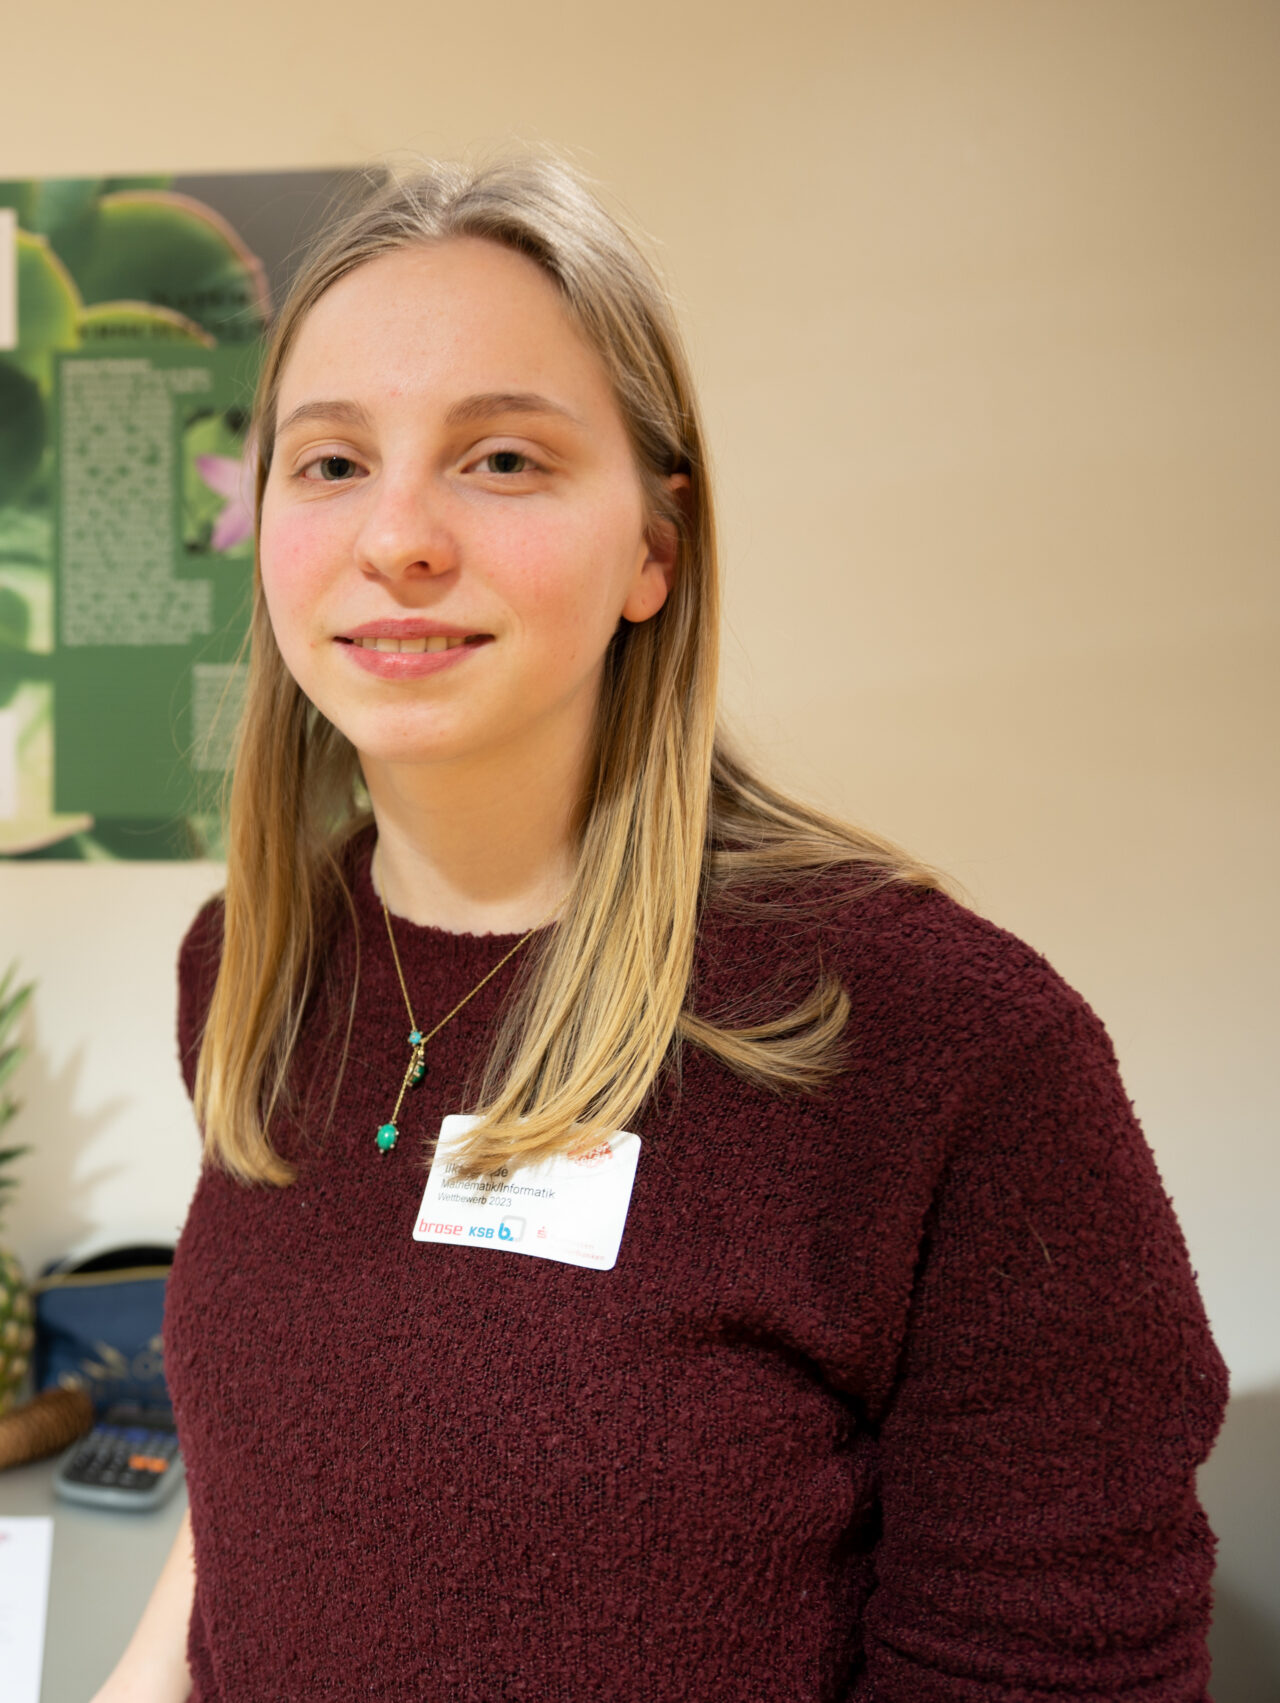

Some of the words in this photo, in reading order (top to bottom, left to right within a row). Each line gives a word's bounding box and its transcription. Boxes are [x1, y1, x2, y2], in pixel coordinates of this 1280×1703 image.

[440, 1178, 556, 1199] Mathematik/Informatik
[438, 1192, 487, 1206] Wettbewerb
[488, 1195, 512, 1208] 2023
[419, 1218, 463, 1236] brose
[469, 1226, 495, 1239] KSB
